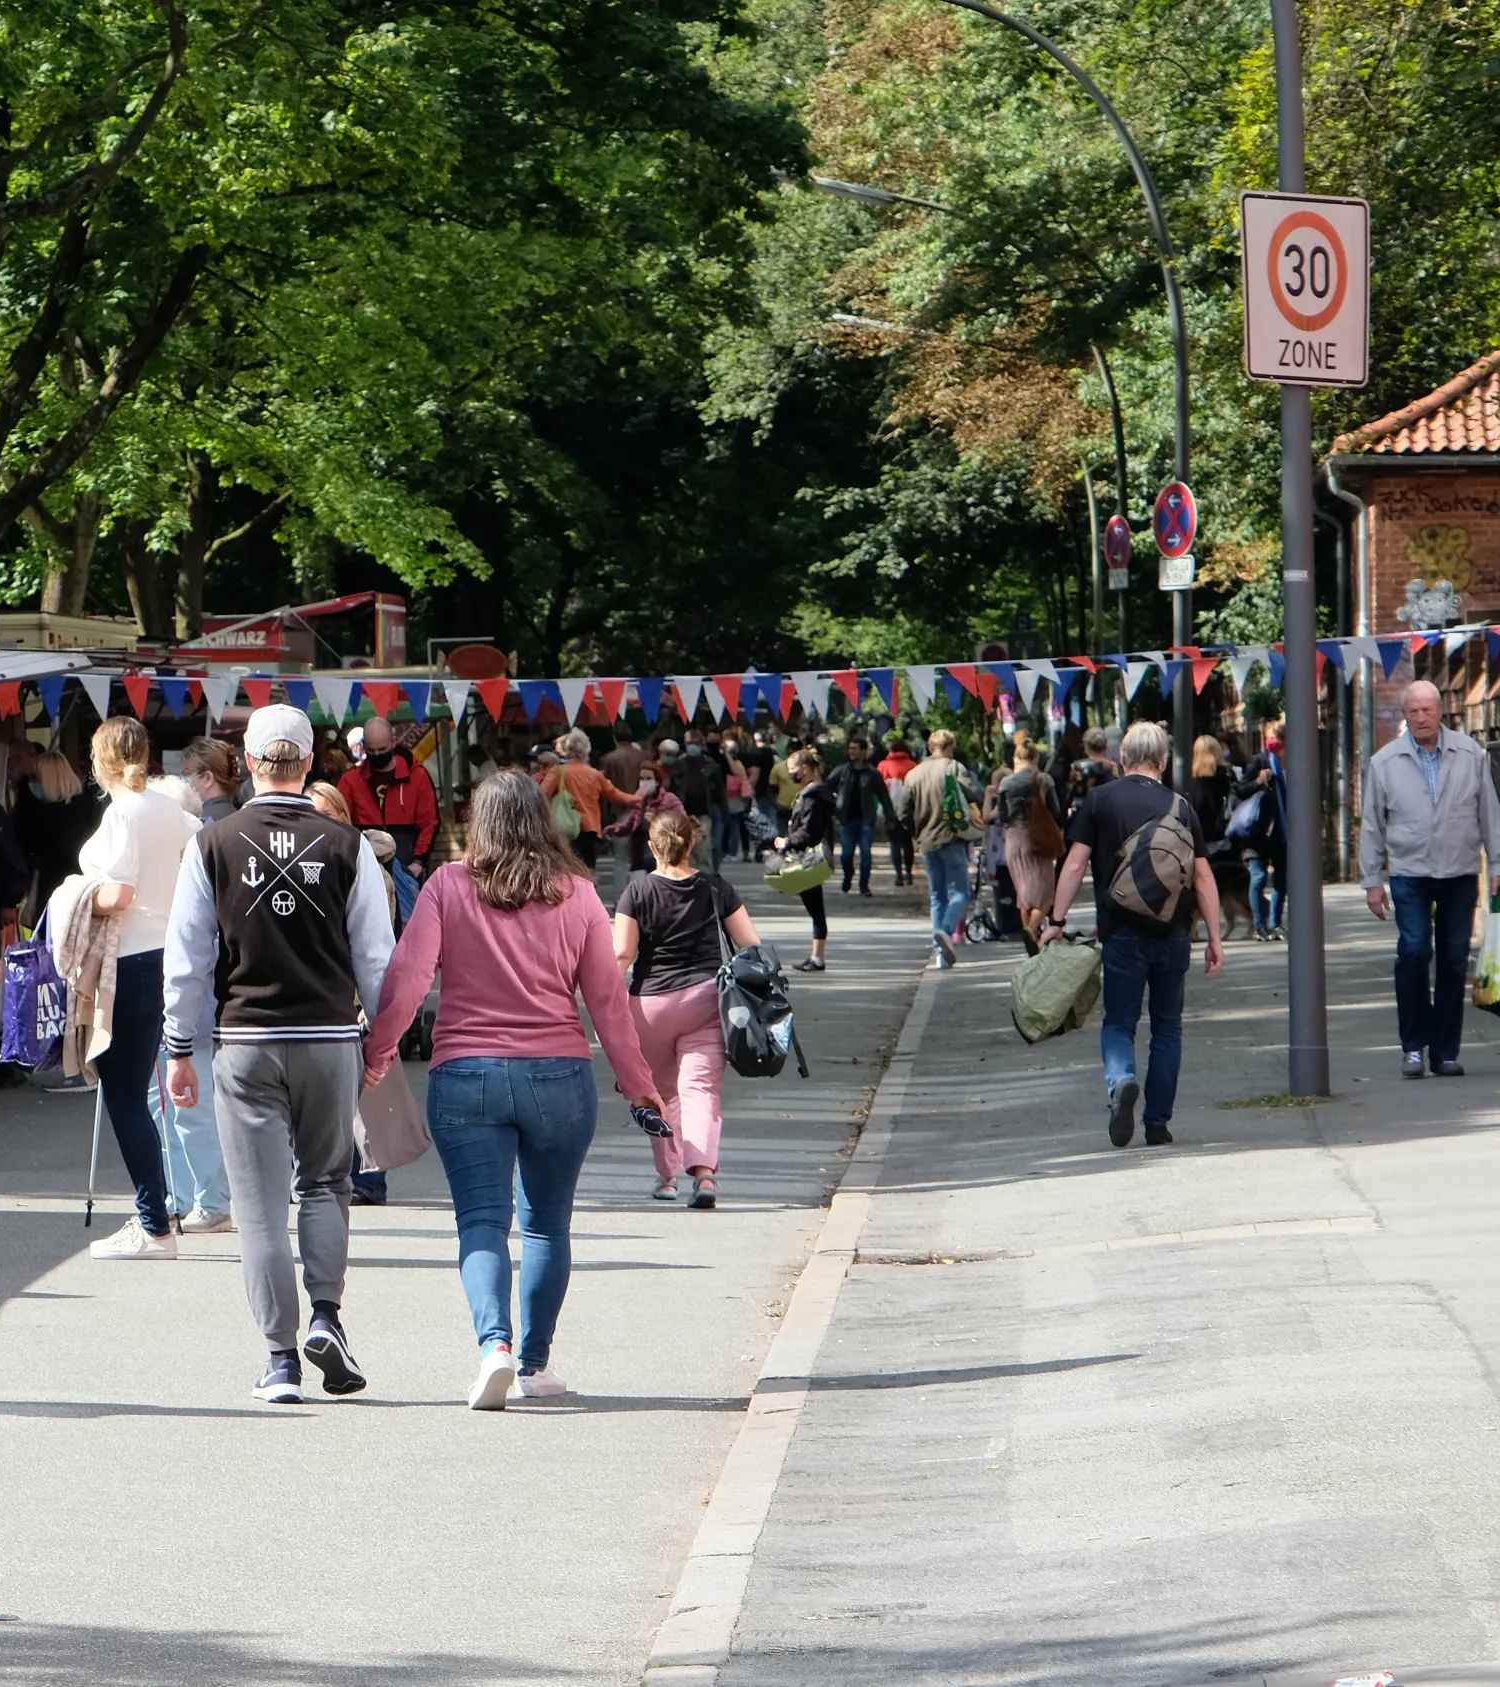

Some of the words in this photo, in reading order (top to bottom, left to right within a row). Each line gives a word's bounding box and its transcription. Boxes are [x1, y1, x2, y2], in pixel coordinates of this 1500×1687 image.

[1284, 244, 1329, 298] 30
[1279, 339, 1337, 369] ZONE
[269, 831, 295, 859] HH
